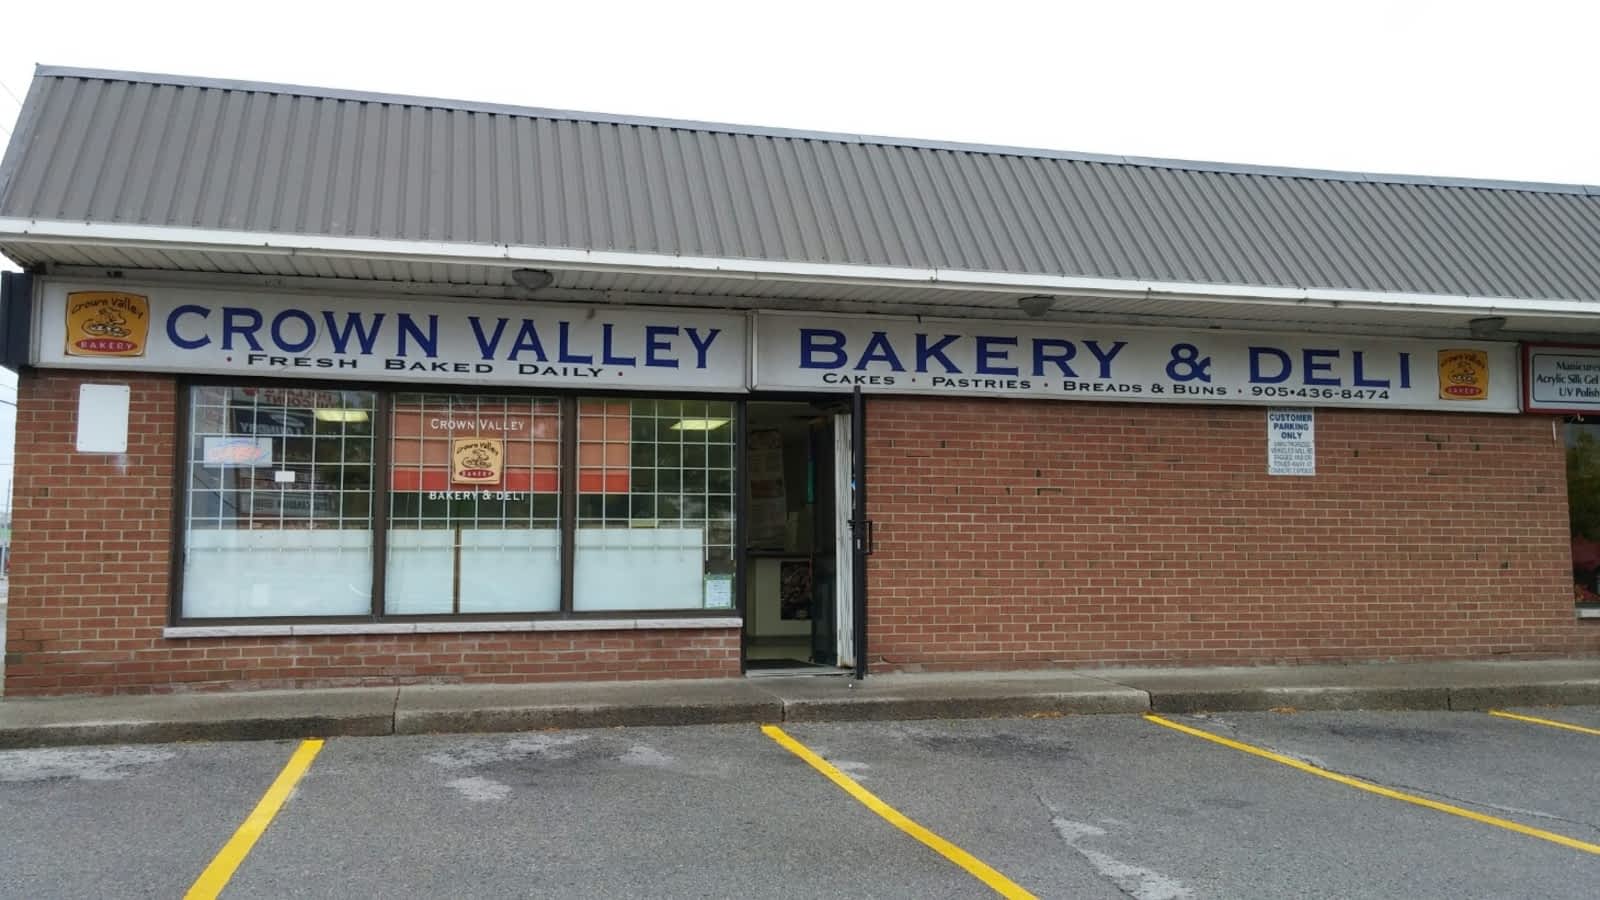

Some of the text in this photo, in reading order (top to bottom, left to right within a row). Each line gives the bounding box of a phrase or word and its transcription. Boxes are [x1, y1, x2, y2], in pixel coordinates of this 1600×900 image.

[166, 304, 721, 369] CROWN VALLEY
[248, 354, 604, 378] FRESH BAKED DAILY
[798, 328, 1411, 389] BAKERY & DELI
[822, 373, 896, 385] CAKES
[932, 377, 1031, 390] PASTRIES
[1064, 381, 1142, 393] BREADS
[1151, 384, 1164, 394] &
[1173, 384, 1228, 396] BUNS
[1536, 374, 1598, 386] Acrylic Silk Gel
[1559, 388, 1600, 397] UV Polish
[431, 418, 525, 431] CROWN VALLEY
[429, 490, 525, 501] BAKERY & DELI
